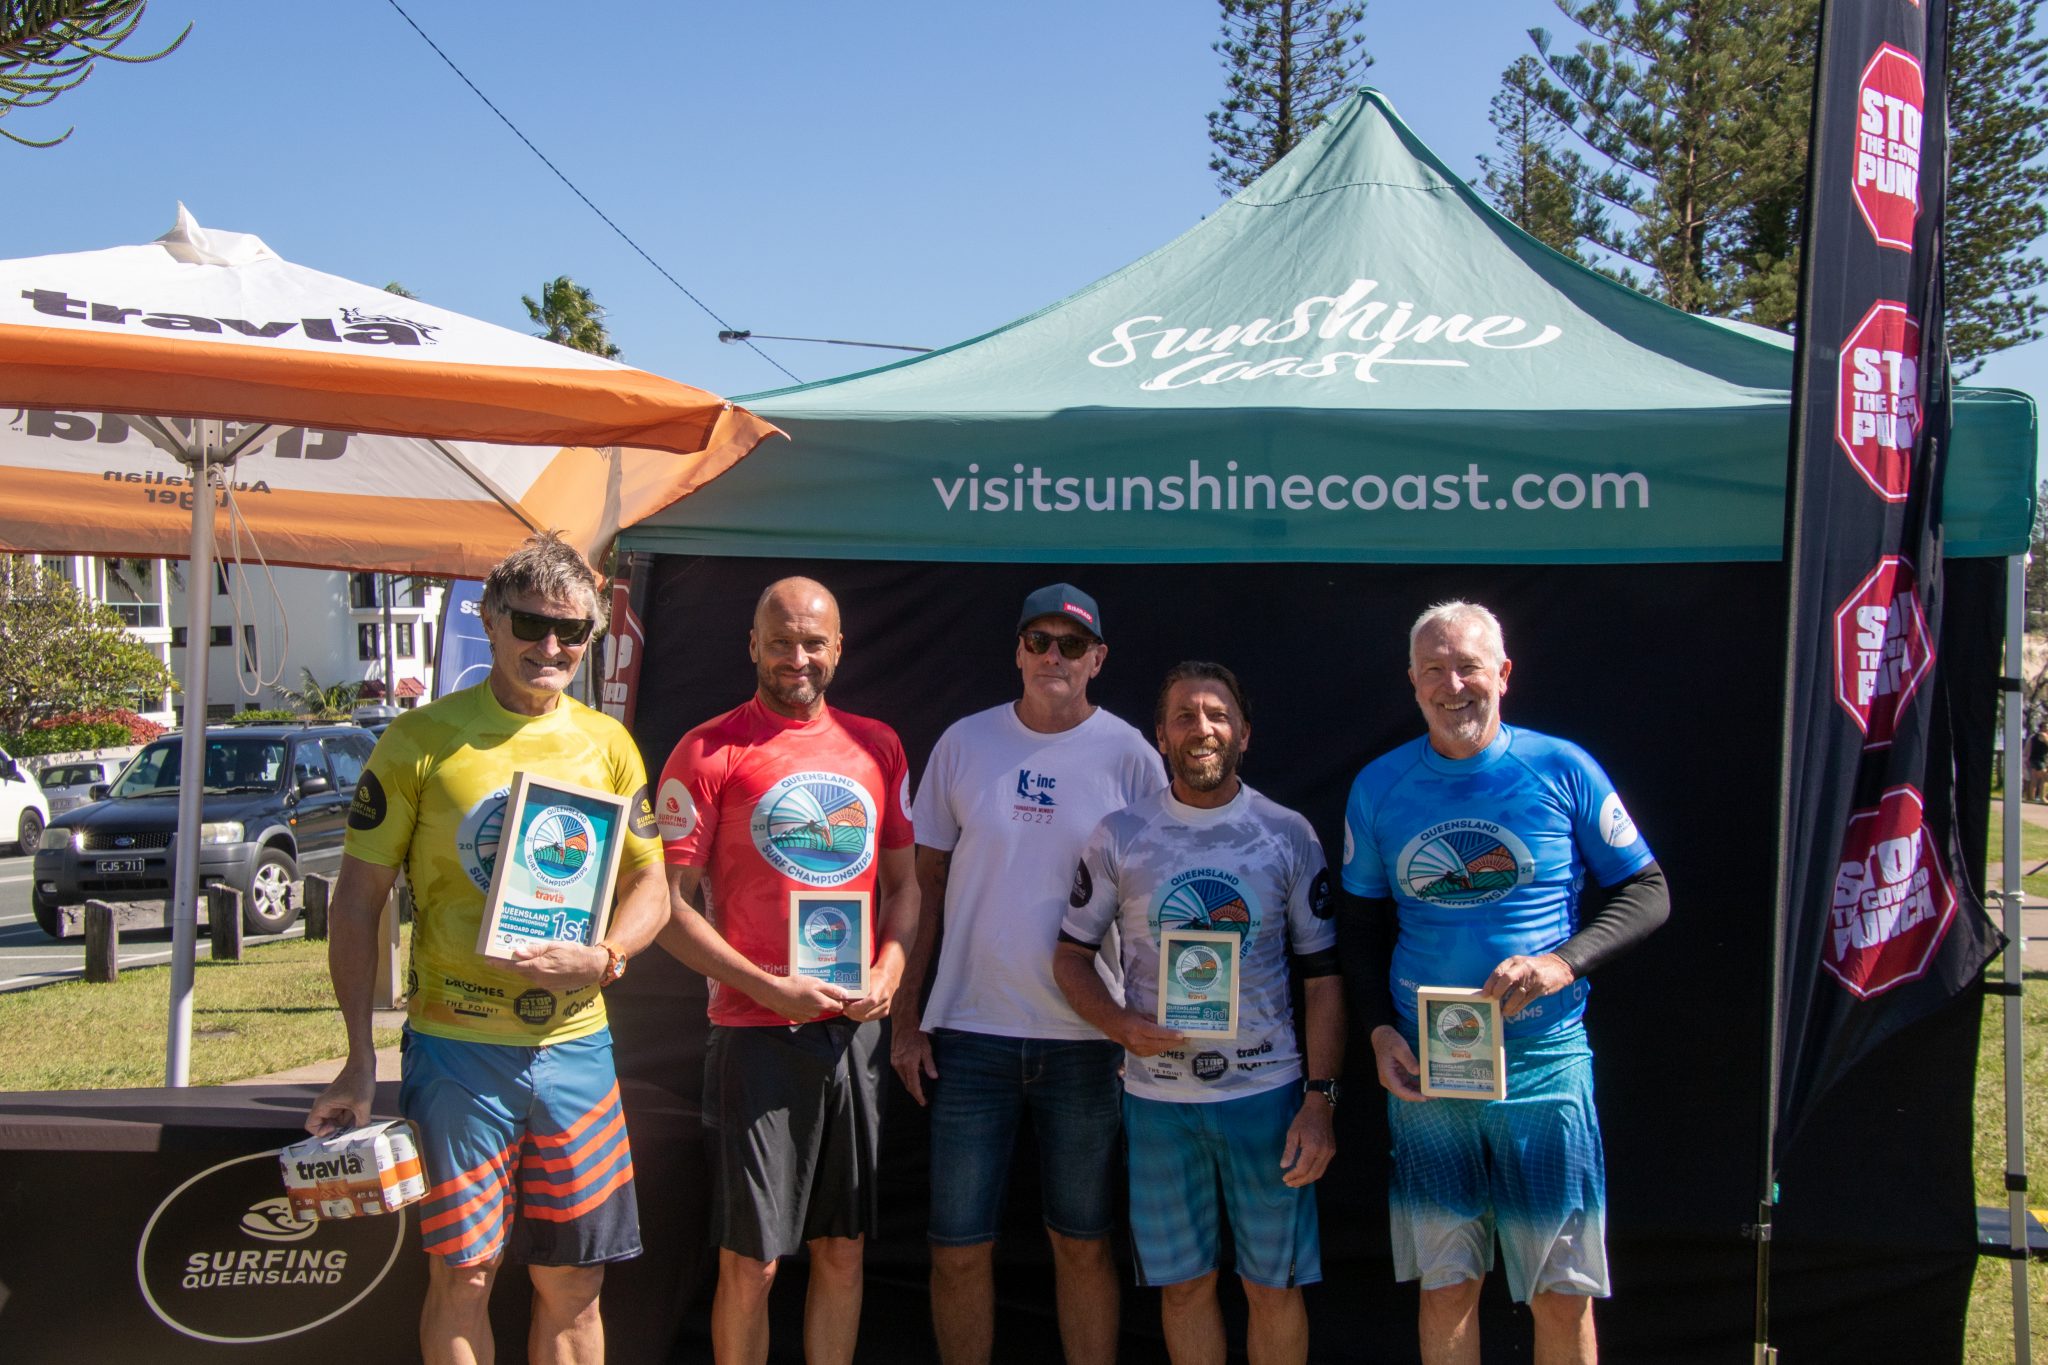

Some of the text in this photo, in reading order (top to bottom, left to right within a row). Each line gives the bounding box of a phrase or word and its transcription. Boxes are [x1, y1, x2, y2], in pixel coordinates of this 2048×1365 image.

[1860, 131, 1886, 156] THE
[22, 288, 422, 346] travla
[1853, 391, 1888, 412] THE
[932, 461, 1649, 511] visitsunshinecoast.com
[781, 773, 855, 789] QUEENSLAND
[547, 806, 588, 824] QUEENSLAND
[1012, 811, 1053, 824] 2022
[1421, 820, 1500, 841] QUEENSLAND
[458, 842, 473, 850] 20
[527, 854, 588, 888] SURF CHAMPIONSHIPS
[762, 844, 872, 884] SURF CHAMPIONSHIPS
[1171, 869, 1239, 886] QUEENSLAND
[535, 889, 565, 904] travla
[530, 928, 545, 936] OPEN
[553, 912, 590, 945] 1st
[446, 1001, 463, 1009] THE
[468, 1004, 500, 1014] POINT
[520, 996, 552, 1007] STOP
[1203, 1008, 1226, 1020] 3rd
[296, 1154, 362, 1180] travla
[185, 1250, 348, 1273] SURFING
[182, 1270, 342, 1289] QUEENSLAND
